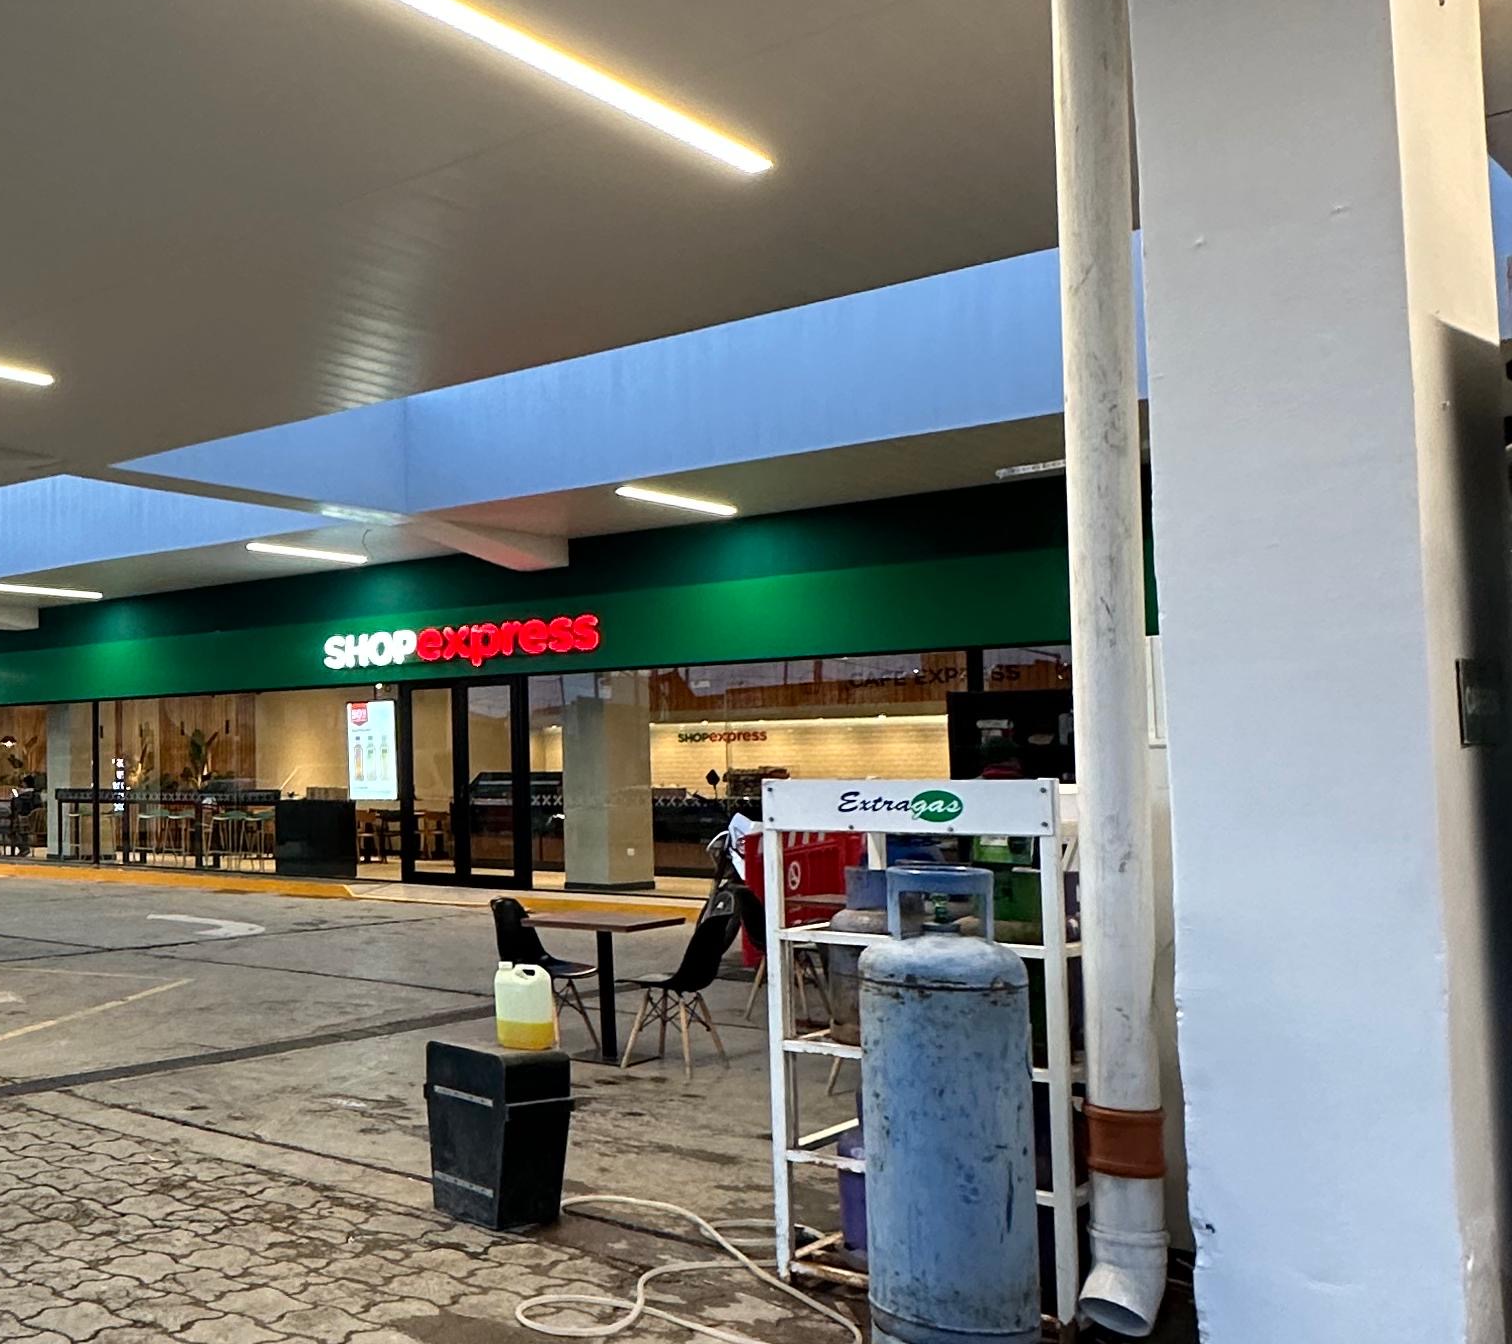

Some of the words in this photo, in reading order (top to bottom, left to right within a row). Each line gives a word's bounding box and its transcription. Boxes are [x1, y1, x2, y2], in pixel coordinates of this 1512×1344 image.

[322, 613, 600, 670] SHOPexpress
[677, 730, 768, 744] SHOPexpress
[837, 790, 962, 821] Extragas
